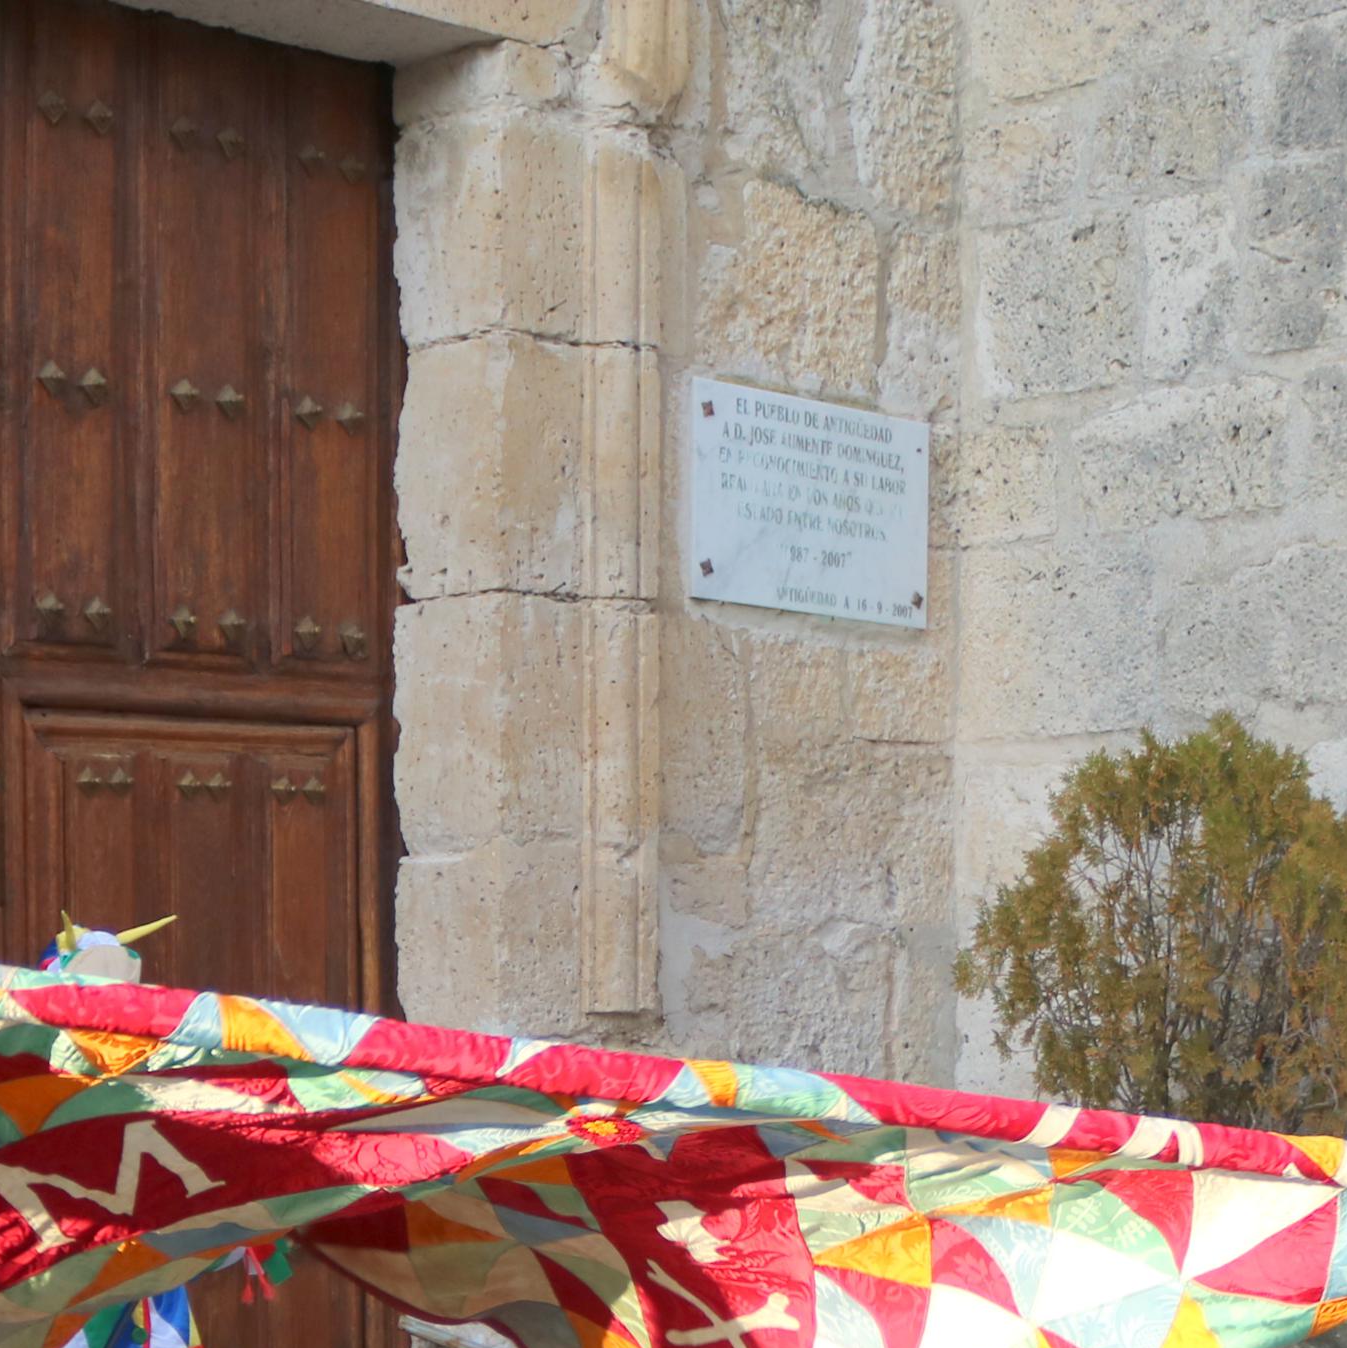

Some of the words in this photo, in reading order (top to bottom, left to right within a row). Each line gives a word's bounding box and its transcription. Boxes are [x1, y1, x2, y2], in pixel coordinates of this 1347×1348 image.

[804, 411, 819, 429] DE
[722, 421, 730, 438] A
[734, 423, 747, 441] D.
[843, 596, 850, 609] A
[892, 604, 913, 619] 2007
